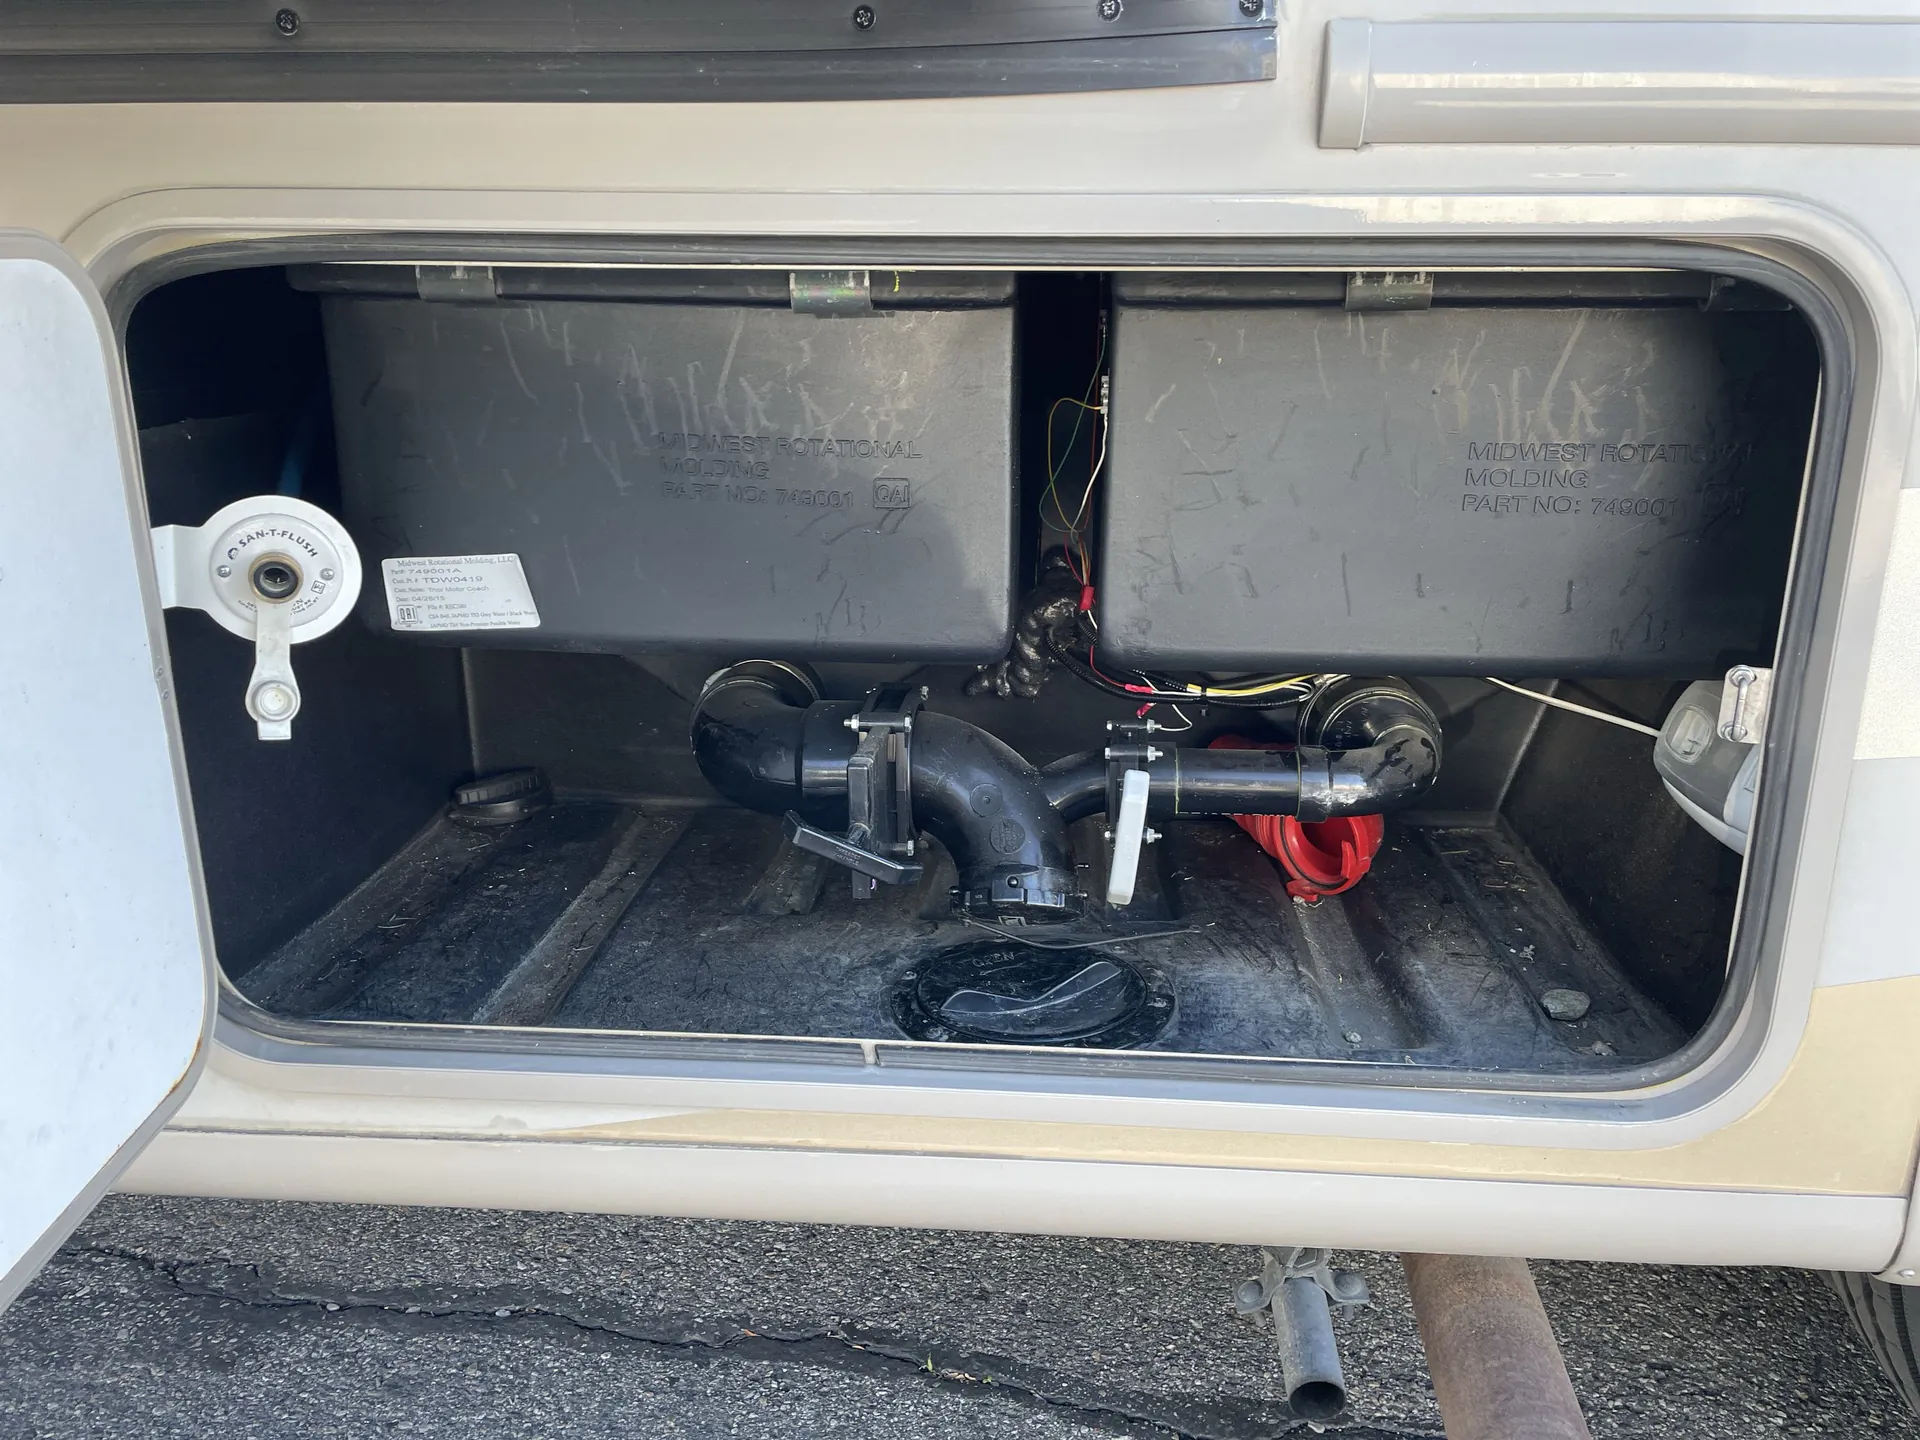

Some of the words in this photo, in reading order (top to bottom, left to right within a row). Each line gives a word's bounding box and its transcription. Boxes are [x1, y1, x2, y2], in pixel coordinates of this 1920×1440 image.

[658, 432, 770, 454] MIDWEST
[776, 437, 923, 459] ROTATIONAL
[1467, 441, 1596, 462] MIDWEST
[659, 456, 770, 479] MOLDING
[1464, 468, 1589, 489] MOLDING
[662, 481, 719, 501] PART
[725, 484, 769, 504] NO:
[775, 488, 855, 509] 749001
[876, 484, 909, 503] QAI
[1461, 493, 1531, 513] PART
[1532, 495, 1581, 515] NO:
[1591, 496, 1679, 517] 749001
[238, 528, 318, 558] SAN-T-FLUSH
[397, 560, 427, 568] Midwest
[428, 558, 462, 566] Rotational
[497, 555, 515, 563] LLC
[408, 567, 462, 575] 749001A
[423, 576, 483, 584] TDW0419
[399, 607, 417, 620] QAI
